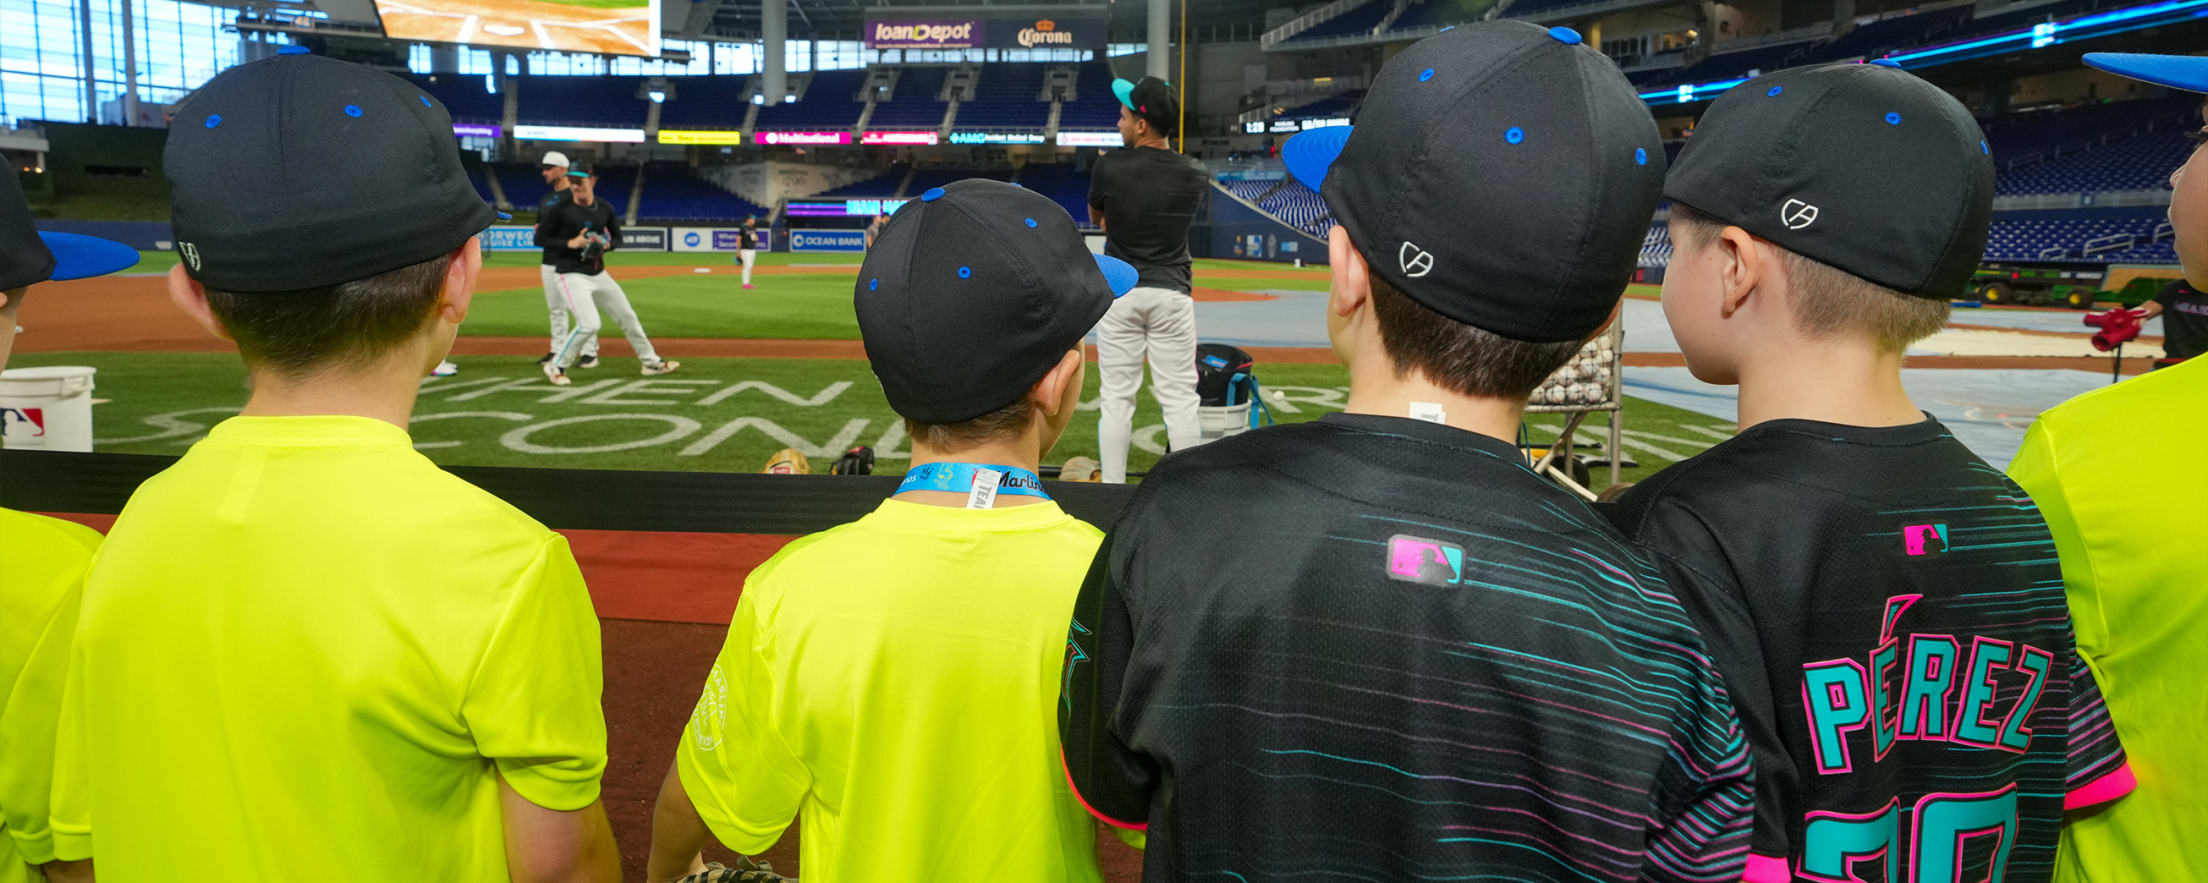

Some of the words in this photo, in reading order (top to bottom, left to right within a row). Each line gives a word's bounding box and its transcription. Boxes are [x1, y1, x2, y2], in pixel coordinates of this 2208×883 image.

[875, 23, 972, 43] loanDepot
[1017, 28, 1072, 48] Corona
[806, 236, 837, 246] OCEAN
[838, 236, 863, 246] BANK
[999, 470, 1046, 492] Marlin
[973, 484, 992, 509] TEA
